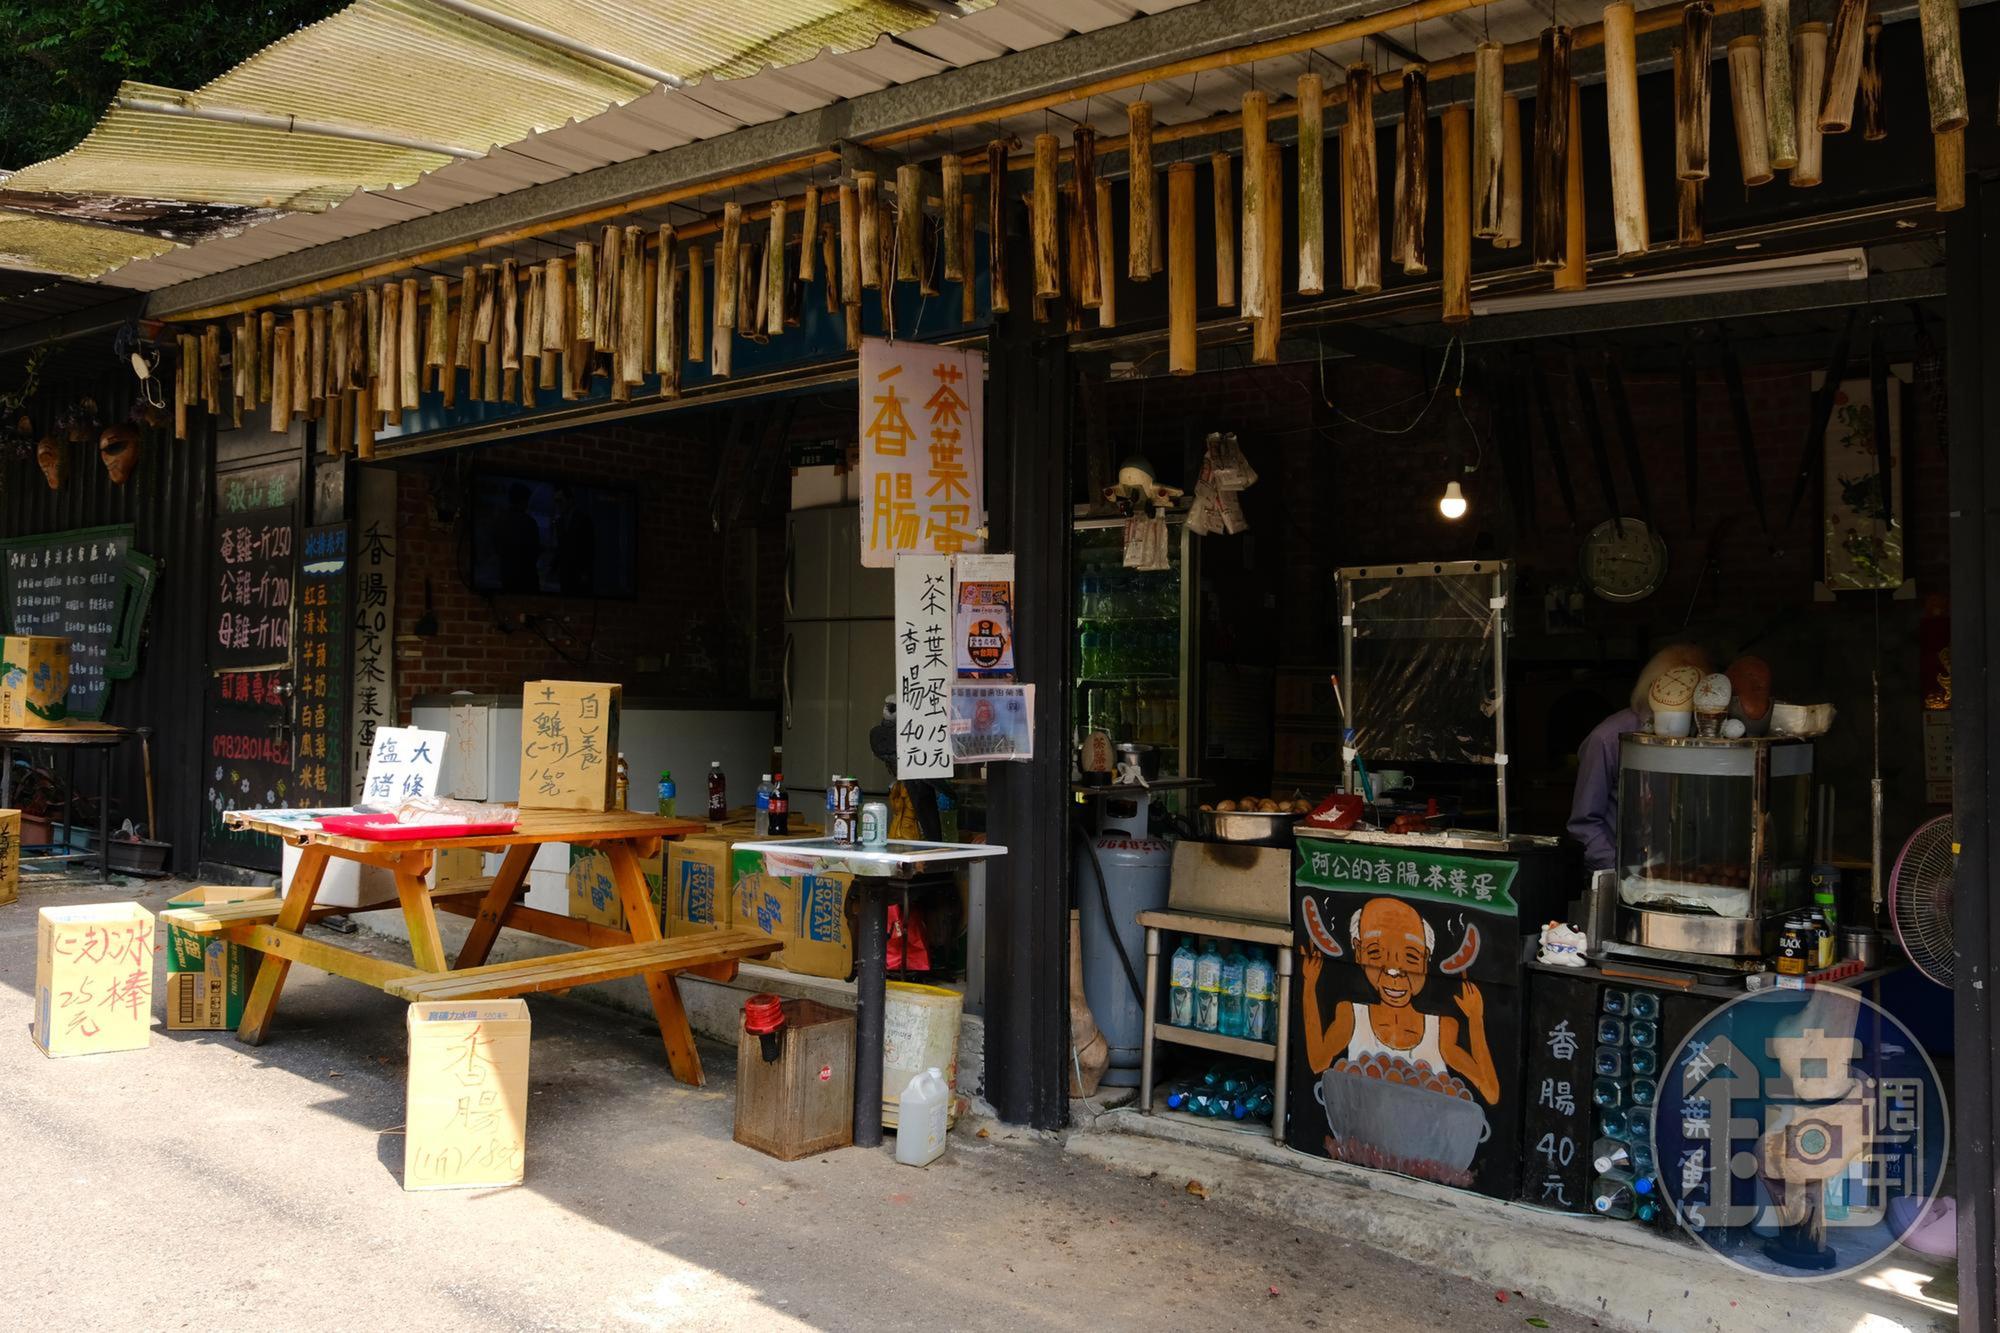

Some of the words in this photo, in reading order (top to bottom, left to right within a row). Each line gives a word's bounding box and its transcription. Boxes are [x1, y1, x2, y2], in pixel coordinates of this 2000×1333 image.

[865, 365, 921, 551] 香腸
[923, 362, 977, 555] 茶葉蛋
[302, 673, 328, 700] 牛奶
[899, 622, 928, 768] 香腸40元
[920, 573, 950, 769] 茶葉蛋15元
[301, 703, 328, 729] 百香
[698, 864, 706, 924] POCARI
[814, 877, 823, 935] SWEAT
[822, 879, 833, 942] POCARI
[1311, 851, 1498, 903] 阿公的香腸茶葉蛋
[98, 919, 155, 1021] 冰棒
[1780, 938, 1801, 949] BLACK
[442, 1025, 503, 1133] 香腸
[1536, 1019, 1581, 1207] 香腸40元
